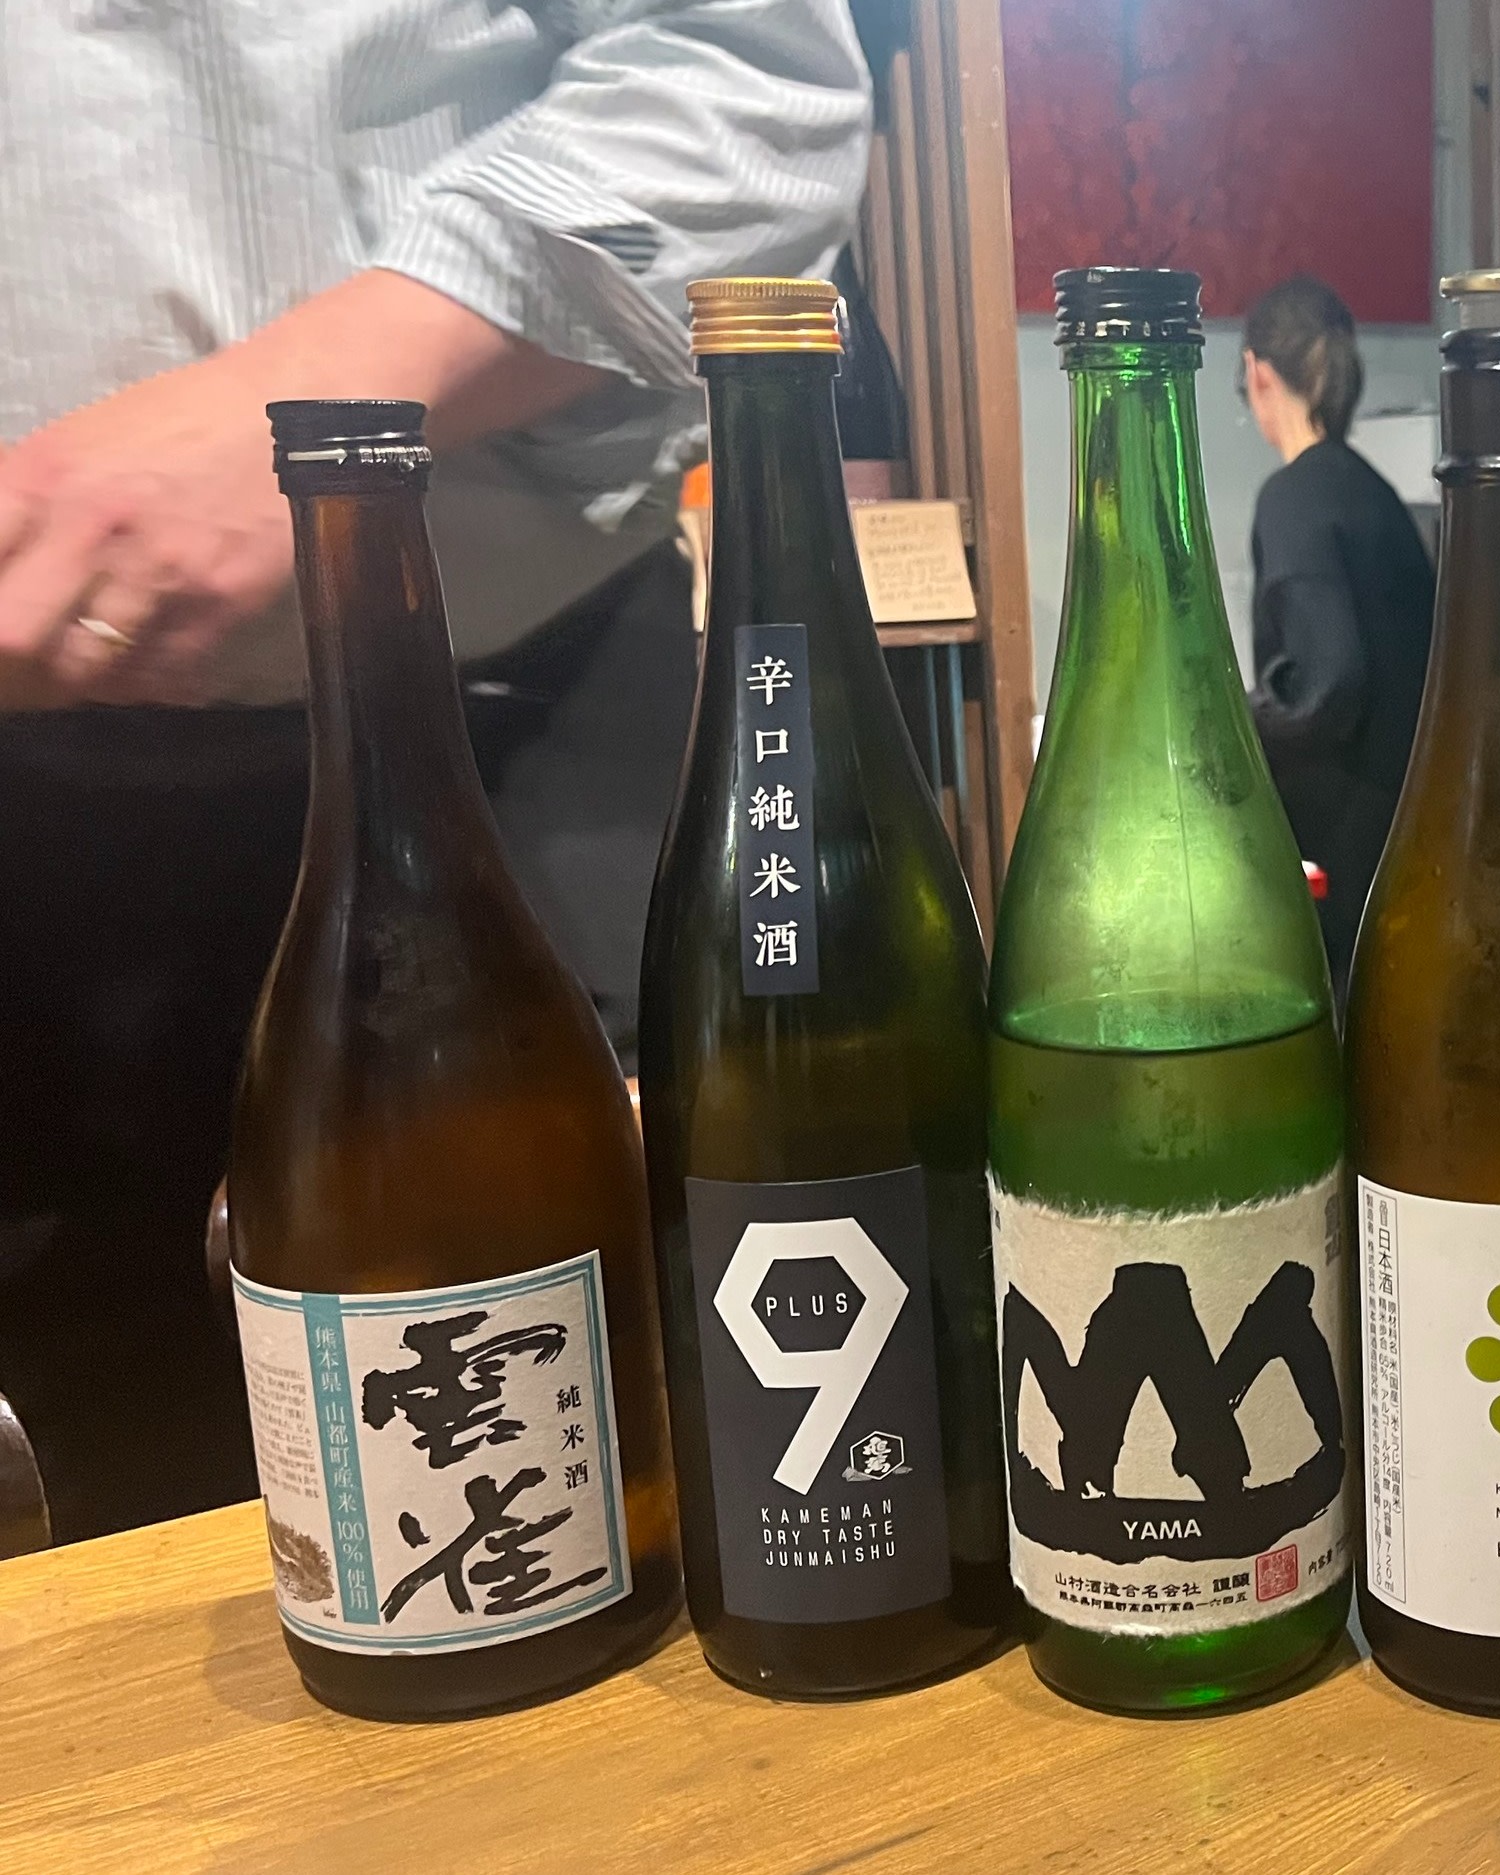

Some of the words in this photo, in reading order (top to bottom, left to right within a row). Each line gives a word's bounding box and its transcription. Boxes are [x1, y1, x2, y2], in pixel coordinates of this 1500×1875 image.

[746, 655, 801, 967] 辛口純米酒
[1378, 1227, 1393, 1296] 日本酒
[765, 1292, 850, 1317] PLUS
[315, 1326, 344, 1393] 熊本県
[556, 1384, 589, 1491] 純米酒
[761, 1499, 894, 1525] KAMEMAN
[763, 1528, 802, 1547] DRY
[823, 1520, 895, 1545] TASTE
[1122, 1519, 1202, 1541] YAMA
[765, 1541, 897, 1567] JUNMAISHU
